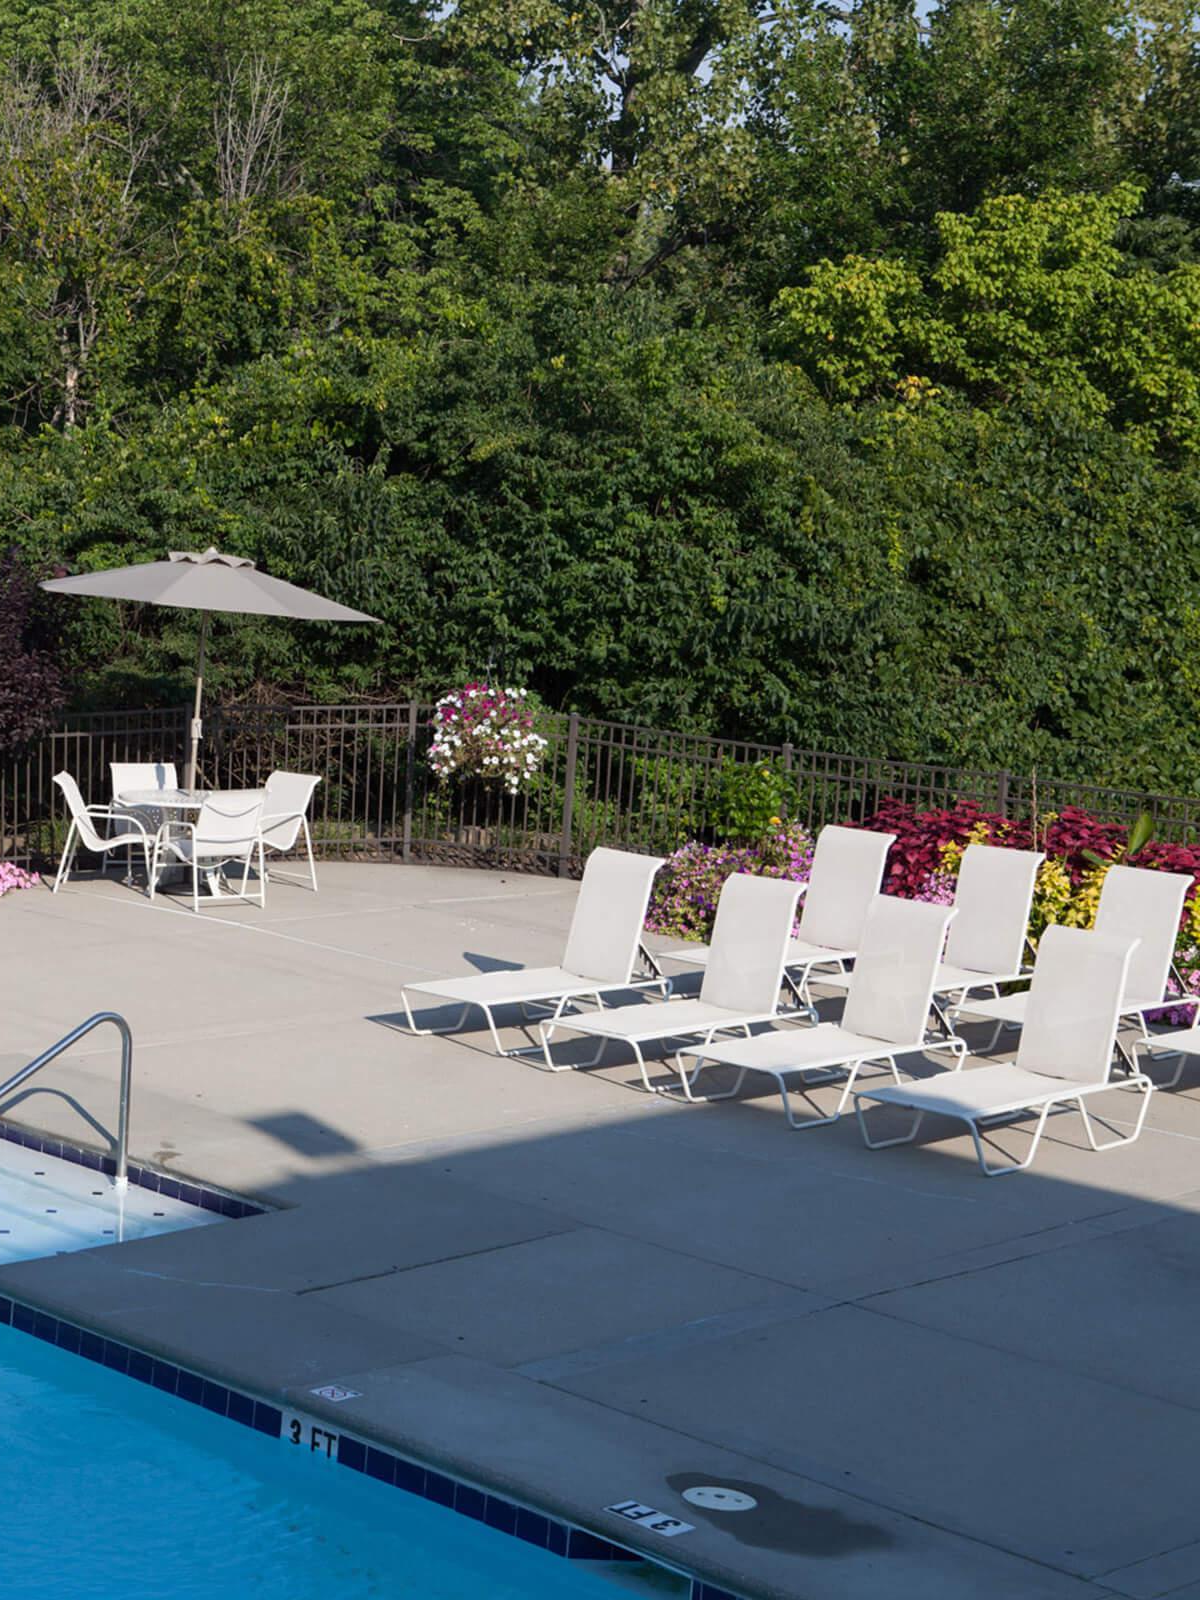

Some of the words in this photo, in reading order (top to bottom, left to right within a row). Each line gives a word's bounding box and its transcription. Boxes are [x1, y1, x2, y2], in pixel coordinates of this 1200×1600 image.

[290, 1419, 302, 1444] 3
[311, 1427, 337, 1459] FT
[609, 1503, 658, 1520] FT
[650, 1519, 682, 1530] 3
